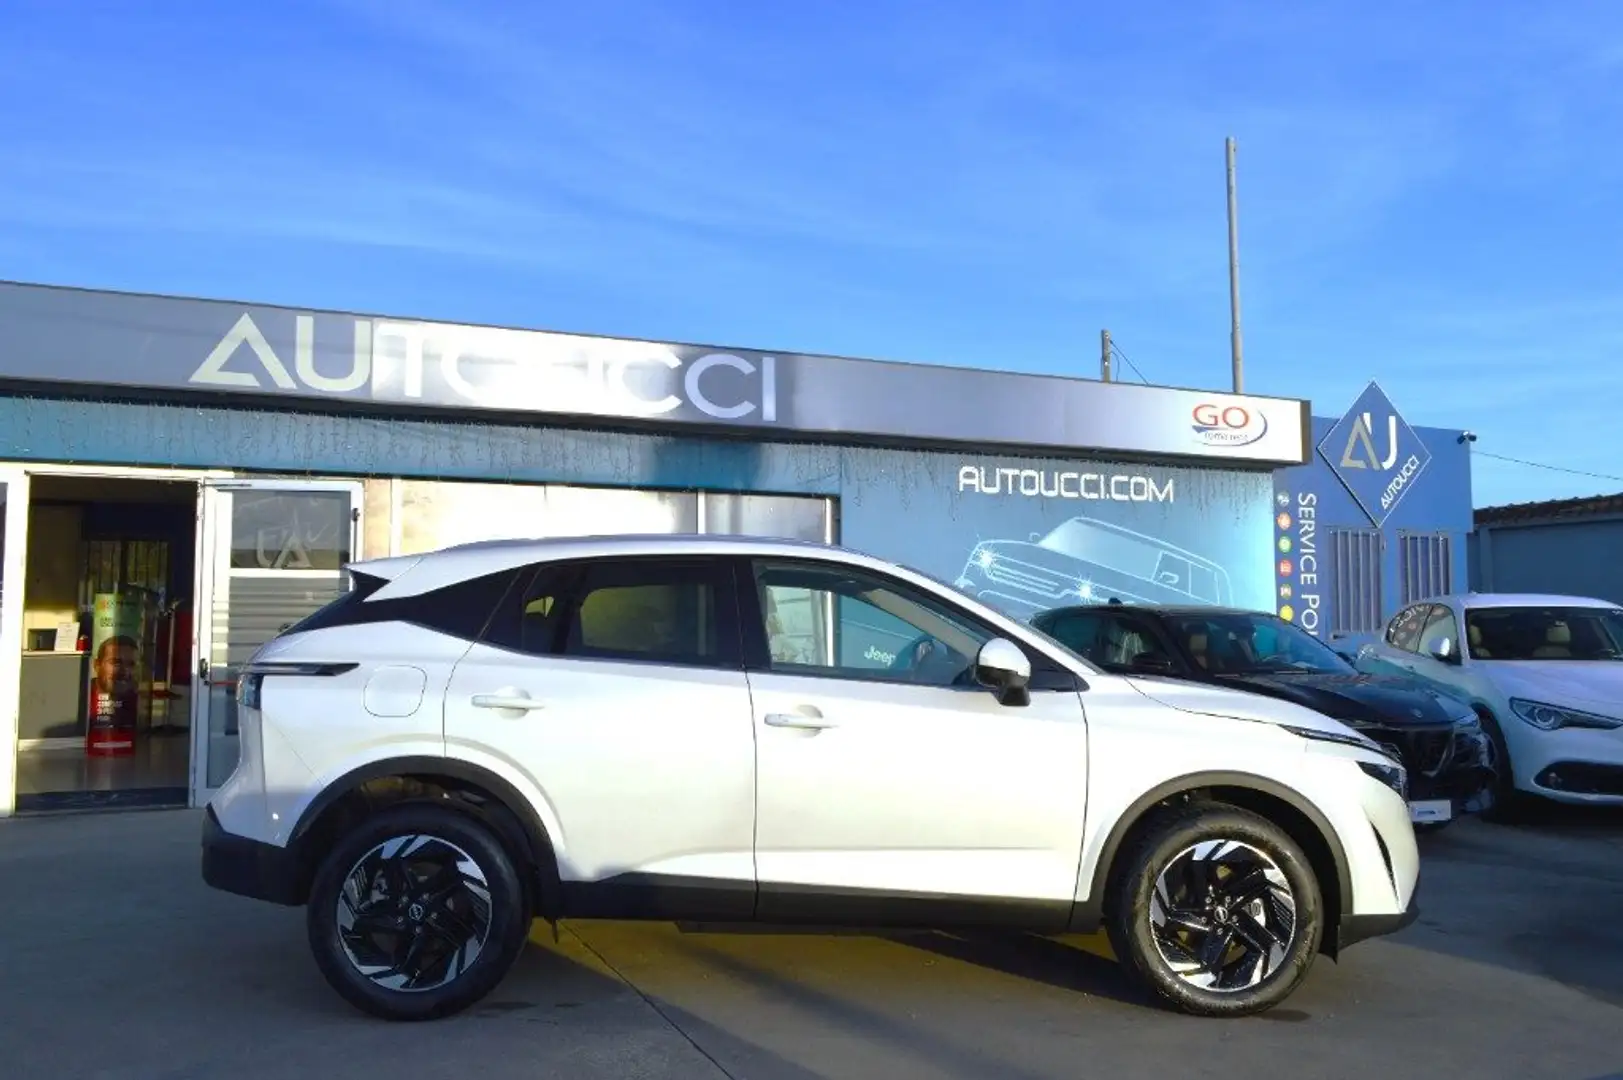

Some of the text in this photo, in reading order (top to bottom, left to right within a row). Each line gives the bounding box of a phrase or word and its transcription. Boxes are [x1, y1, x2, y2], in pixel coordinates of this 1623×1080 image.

[188, 312, 776, 421] AUTOCCI
[1192, 404, 1249, 429] GO
[958, 466, 1174, 503] AUTOUCCI.COM
[1380, 454, 1420, 510] AUTOUCCI
[1298, 492, 1317, 585] SERVICE
